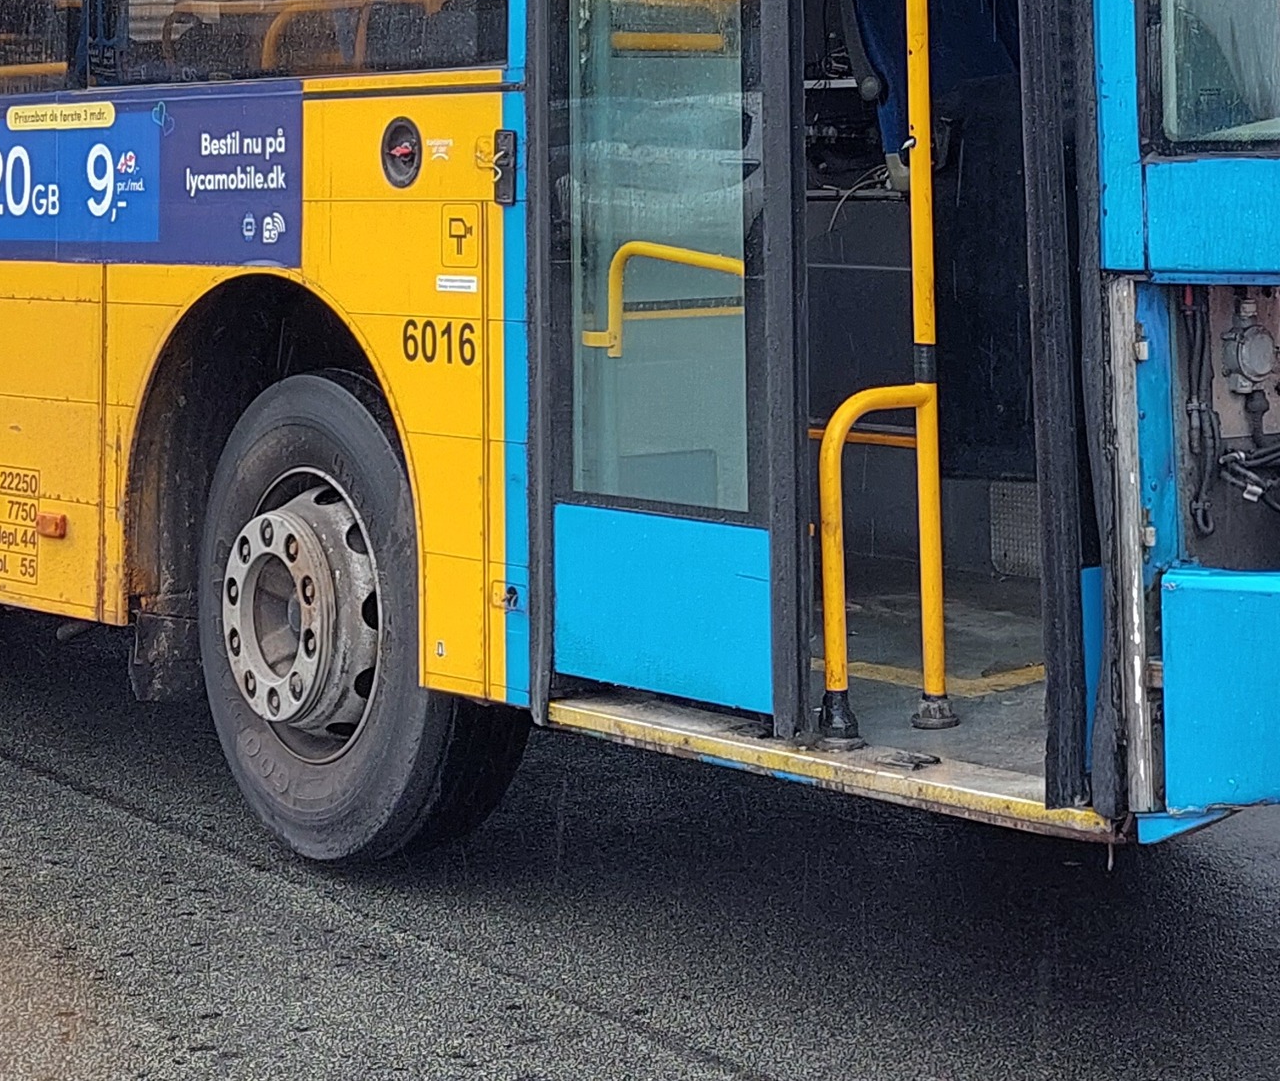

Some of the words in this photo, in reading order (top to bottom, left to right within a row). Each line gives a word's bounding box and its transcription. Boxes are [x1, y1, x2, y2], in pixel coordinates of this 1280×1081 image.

[49, 109, 58, 122] de
[84, 109, 88, 121] 3
[89, 107, 108, 121] mdr.
[201, 130, 240, 155] Bestil
[243, 137, 261, 154] nu
[265, 127, 285, 160] på
[185, 165, 286, 197] lycamobile.dk
[402, 318, 476, 366] 6016
[0, 471, 38, 494] 22250
[7, 500, 37, 522] 7750
[20, 529, 37, 549] 44
[20, 558, 36, 578] 55
